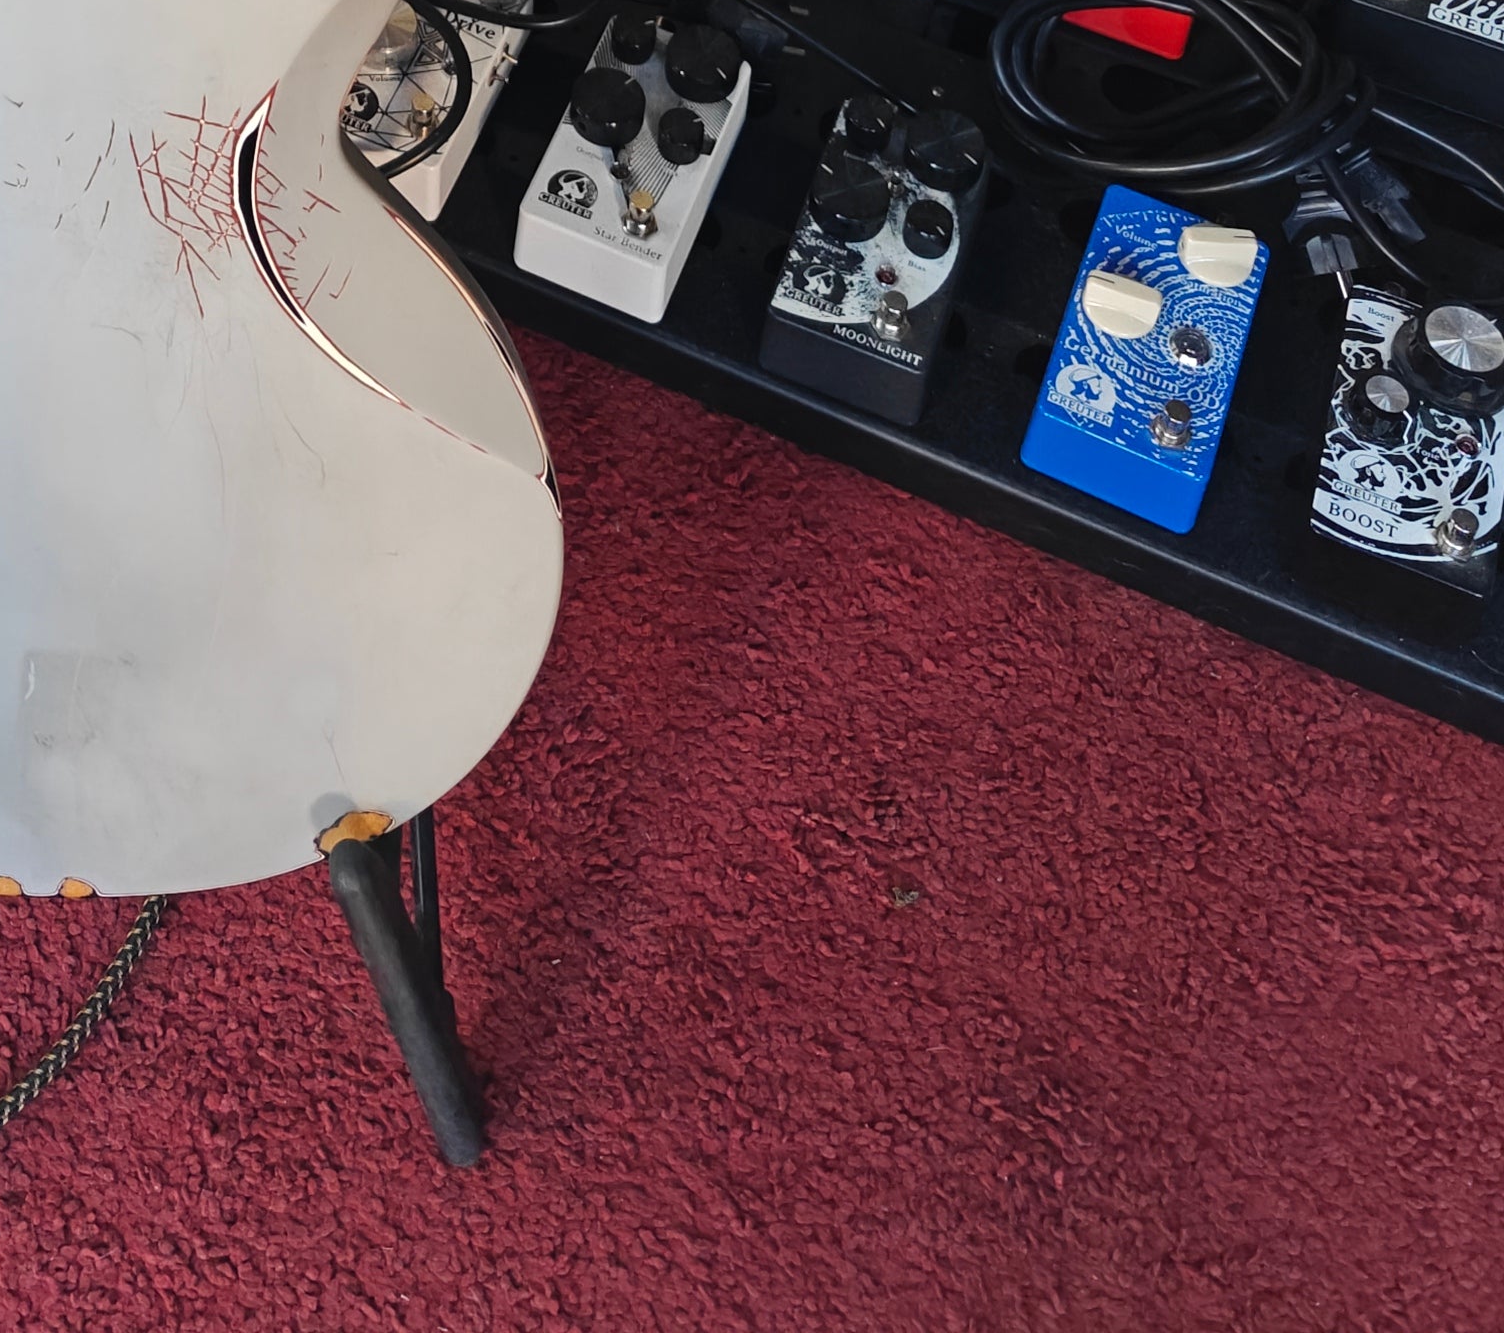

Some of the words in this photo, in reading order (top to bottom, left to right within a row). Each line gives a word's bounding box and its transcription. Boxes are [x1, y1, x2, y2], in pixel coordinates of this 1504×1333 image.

[593, 226, 617, 244] Star
[621, 235, 663, 261] Bender
[1115, 225, 1159, 251] Volume
[786, 289, 843, 317] GREUTER
[1367, 306, 1396, 323] Boost
[832, 324, 923, 367] MOONLIGHT
[1063, 332, 1180, 394] Germanium
[1048, 392, 1112, 426] GREUTER
[1333, 480, 1401, 512] GREUTER
[1328, 501, 1400, 539] BOOST
